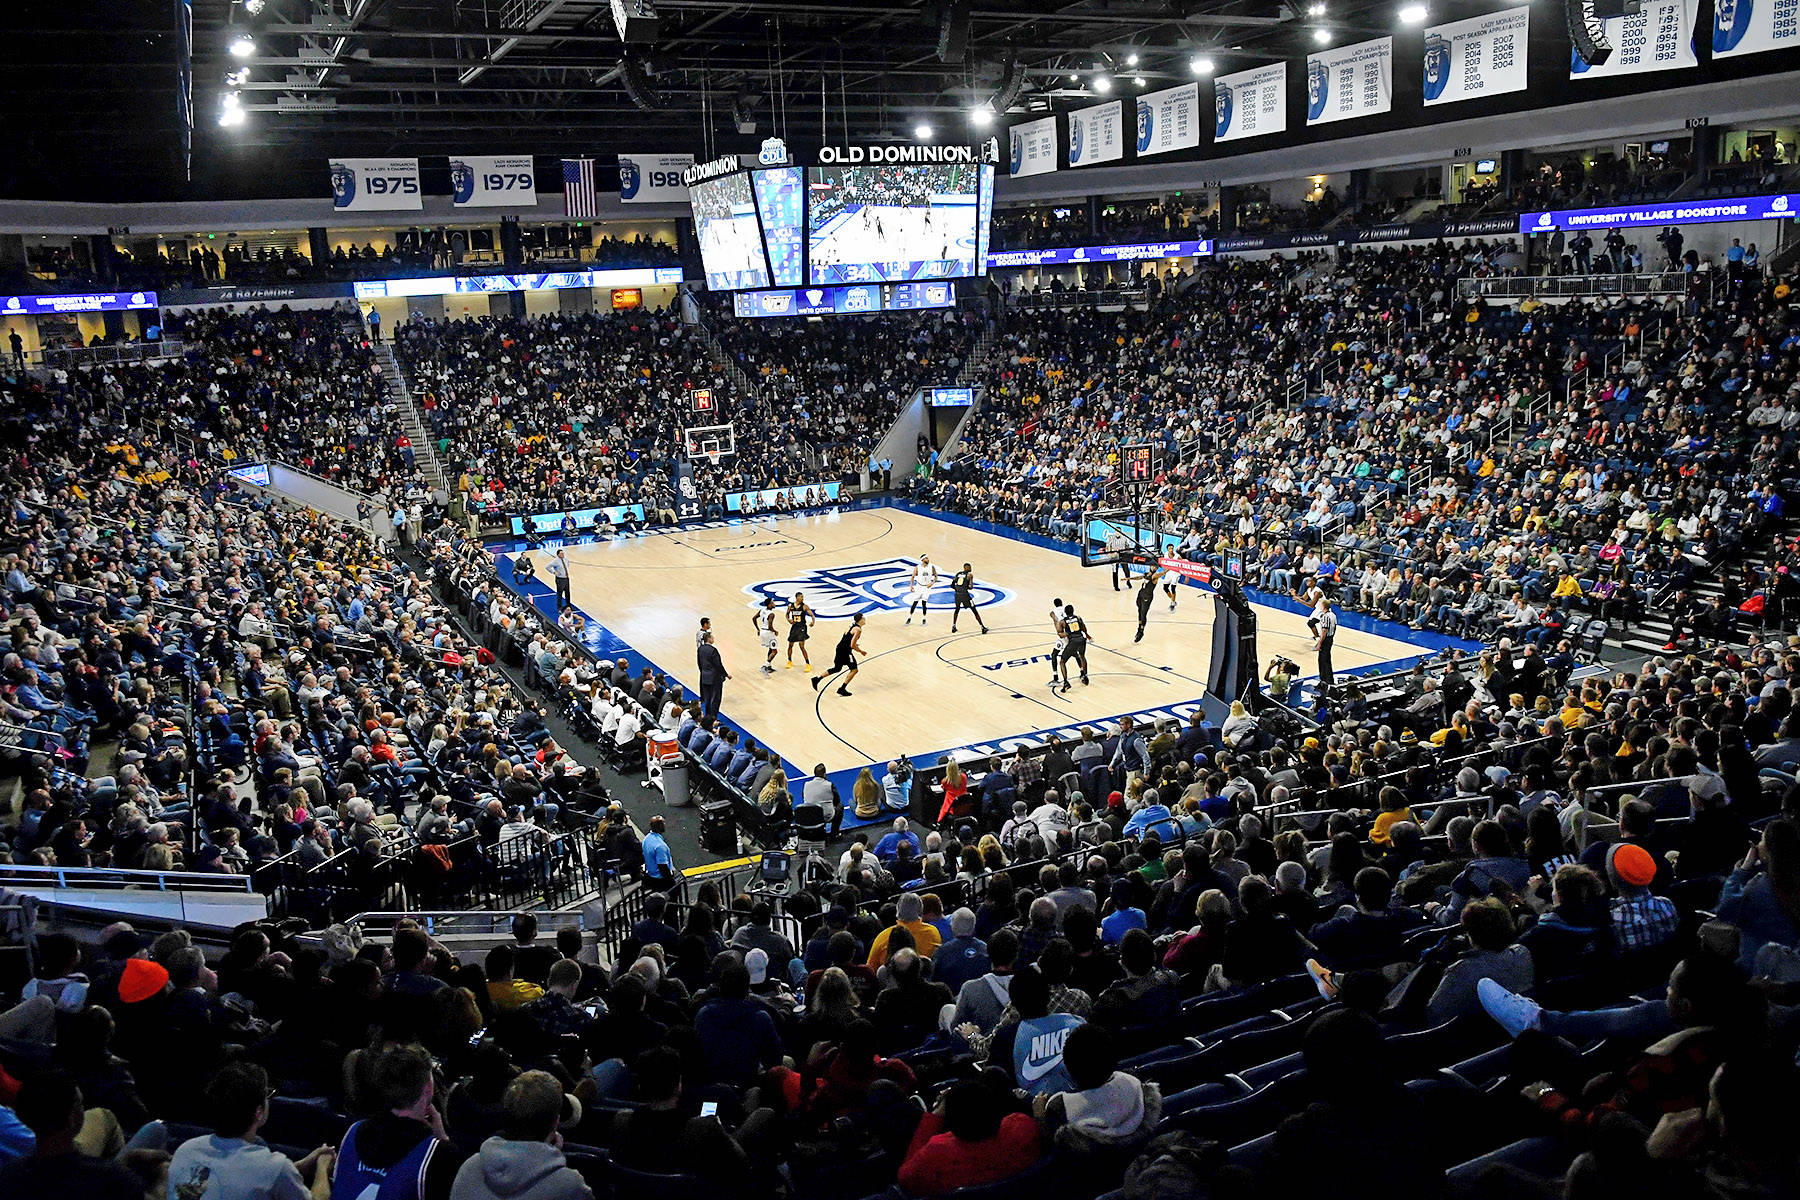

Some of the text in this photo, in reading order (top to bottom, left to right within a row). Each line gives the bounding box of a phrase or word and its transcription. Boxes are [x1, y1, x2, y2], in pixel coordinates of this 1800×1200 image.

[1774, 8, 1797, 19] 1987
[1481, 21, 1494, 29] LADY
[1623, 19, 1647, 29] 2002
[1773, 18, 1797, 29] 1985
[1467, 30, 1487, 38] SEASON
[1622, 29, 1643, 38] 2001
[1772, 28, 1797, 39] 1984
[1465, 35, 1514, 51] 2015 2007
[1622, 33, 1678, 47] 2000 1994
[1465, 43, 1514, 59] 2014 2006
[1621, 42, 1676, 56] 1999 1993
[1464, 52, 1514, 67] 2013 2005
[1620, 52, 1676, 65] 1998 1992
[1340, 62, 1378, 76] 1998 1992
[1464, 60, 1513, 75] 2011 2004
[1340, 70, 1378, 83] 1997 1990
[1464, 74, 1481, 82] 2010
[1340, 82, 1353, 90] 1996
[1364, 85, 1378, 93] 1985
[1464, 81, 1484, 90] 2008
[1364, 92, 1378, 100] 1984
[1340, 104, 1353, 112] 1993
[1689, 119, 1705, 127] 104
[820, 147, 864, 163] OLD
[869, 146, 972, 162] DOMINION
[684, 155, 738, 183] OLD DOMINION
[366, 177, 418, 194] 1975
[484, 174, 533, 190] 1979
[1568, 205, 1747, 226] UNIVERSITY VILLAGE BOOKSTORE
[1445, 220, 1514, 233] 21 PENICHEIRO
[1371, 228, 1410, 238] DONOVAN
[1026, 251, 1056, 259] VILLAGE
[1101, 244, 1180, 255] UNIVERSITY VILLAGE
[996, 258, 1042, 266] BOOKSTORE
[846, 265, 870, 281] 34
[36, 295, 116, 305] UNIVERSITY VILLAGE
[1134, 460, 1148, 479] 14
[1030, 1027, 1070, 1061] NIKE
